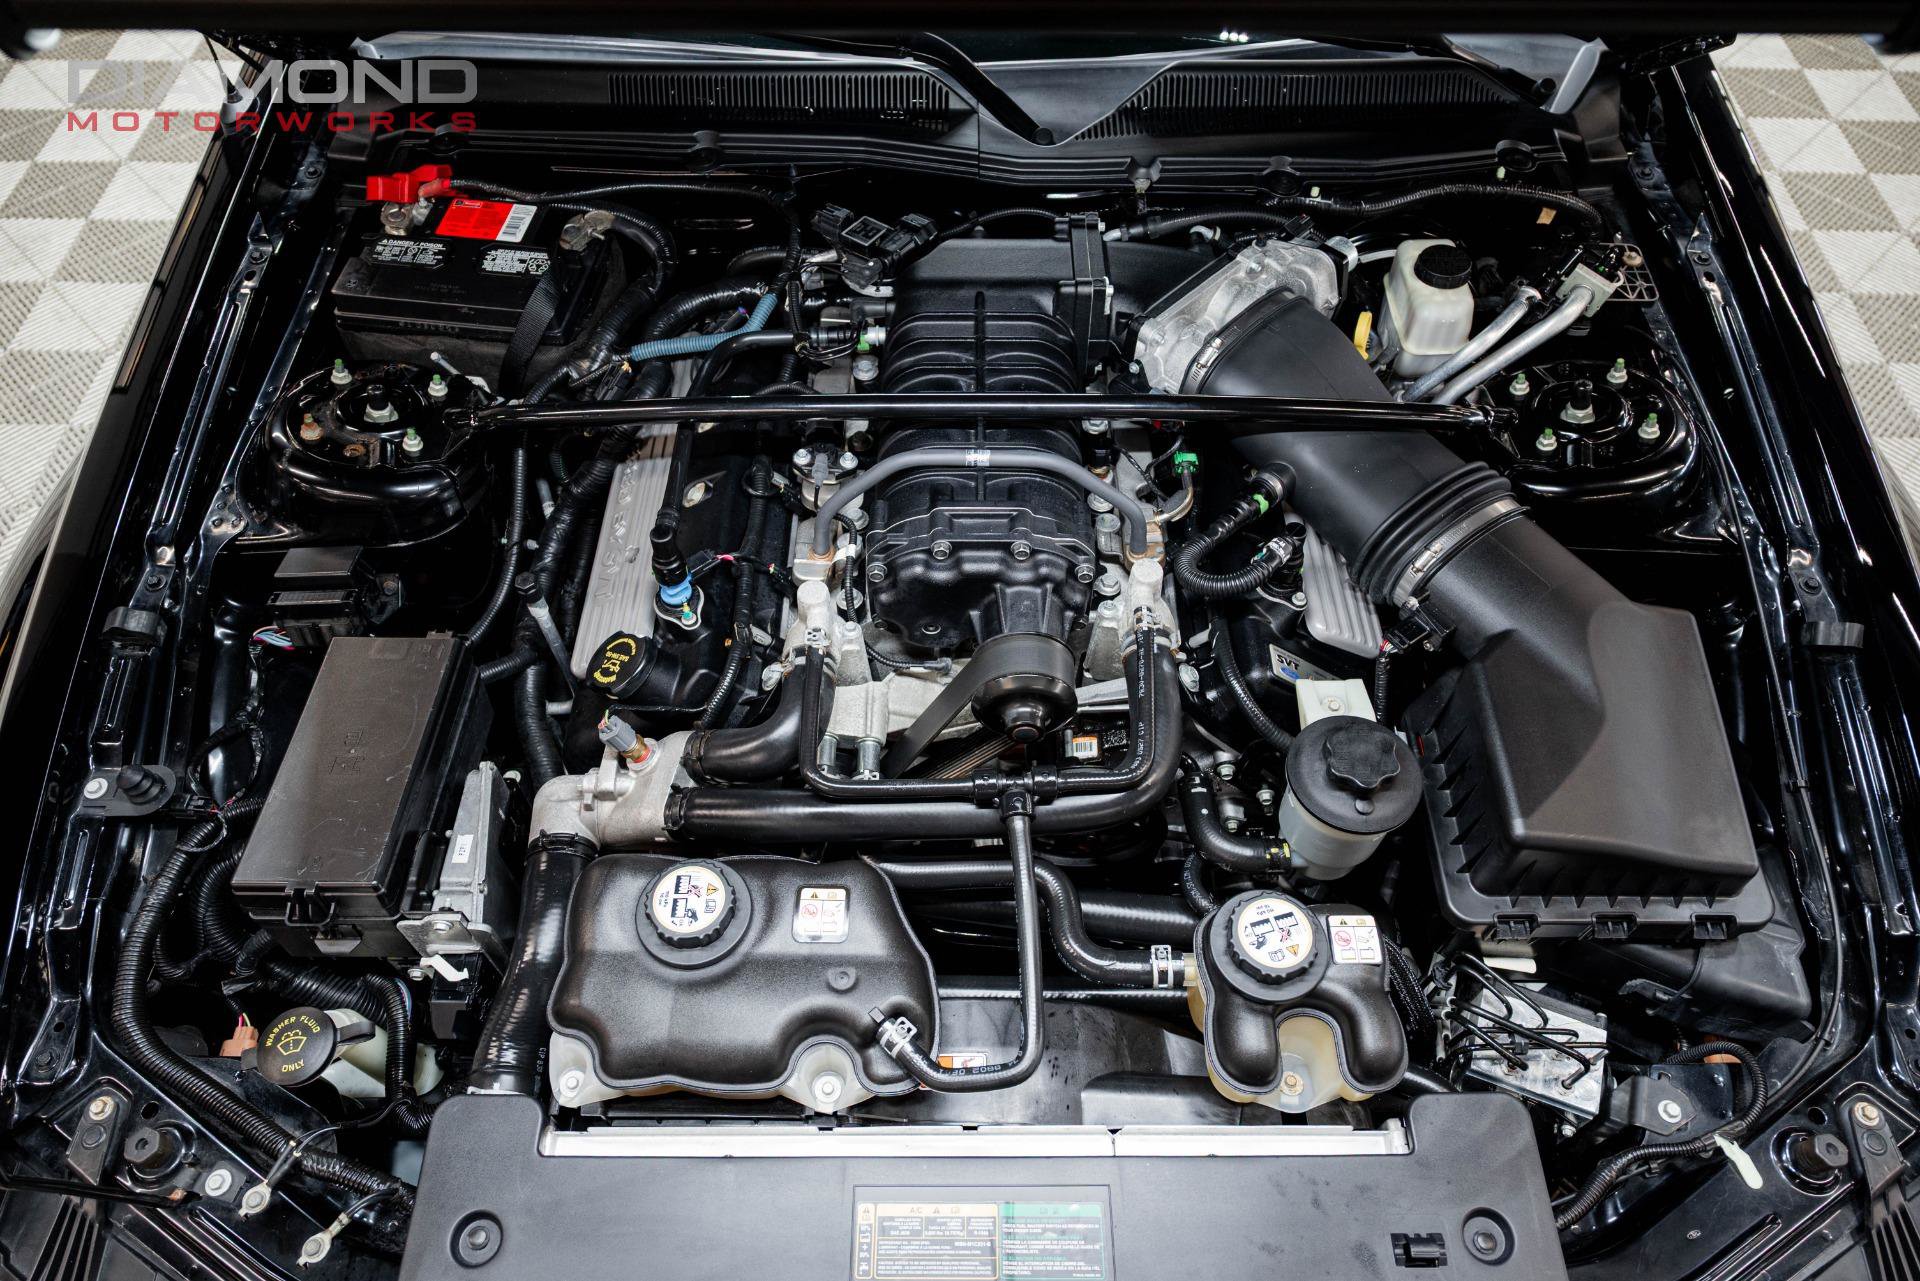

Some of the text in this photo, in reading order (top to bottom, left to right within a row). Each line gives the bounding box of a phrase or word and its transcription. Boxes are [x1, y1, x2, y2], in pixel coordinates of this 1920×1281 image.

[1275, 653, 1300, 670] SVT
[265, 1015, 321, 1047] WASHER FLUID
[281, 1058, 305, 1073] ONLY
